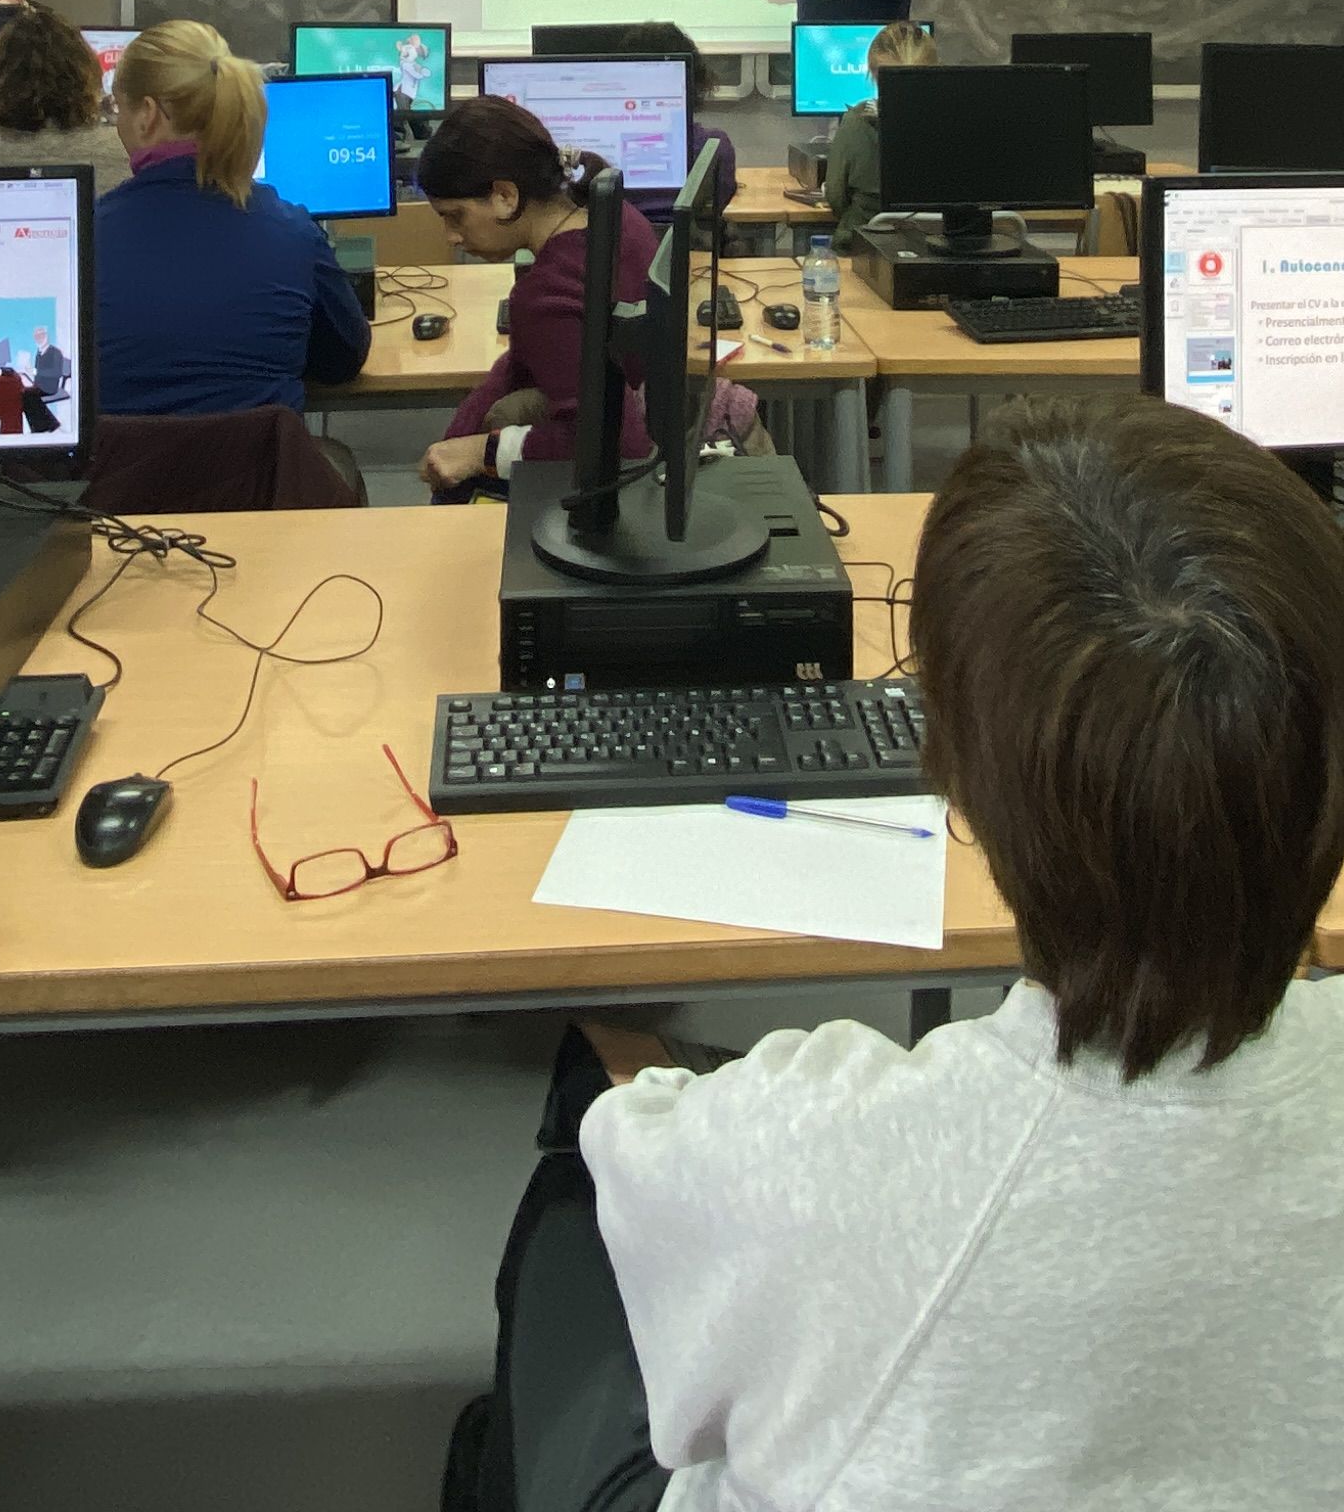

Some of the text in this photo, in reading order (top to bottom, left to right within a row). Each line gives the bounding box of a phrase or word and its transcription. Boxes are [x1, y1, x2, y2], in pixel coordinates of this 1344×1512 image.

[328, 146, 376, 164] 09:54
[1251, 300, 1295, 310] Presentar
[1265, 335, 1301, 346] Correo
[1265, 354, 1322, 366] Inscripción
